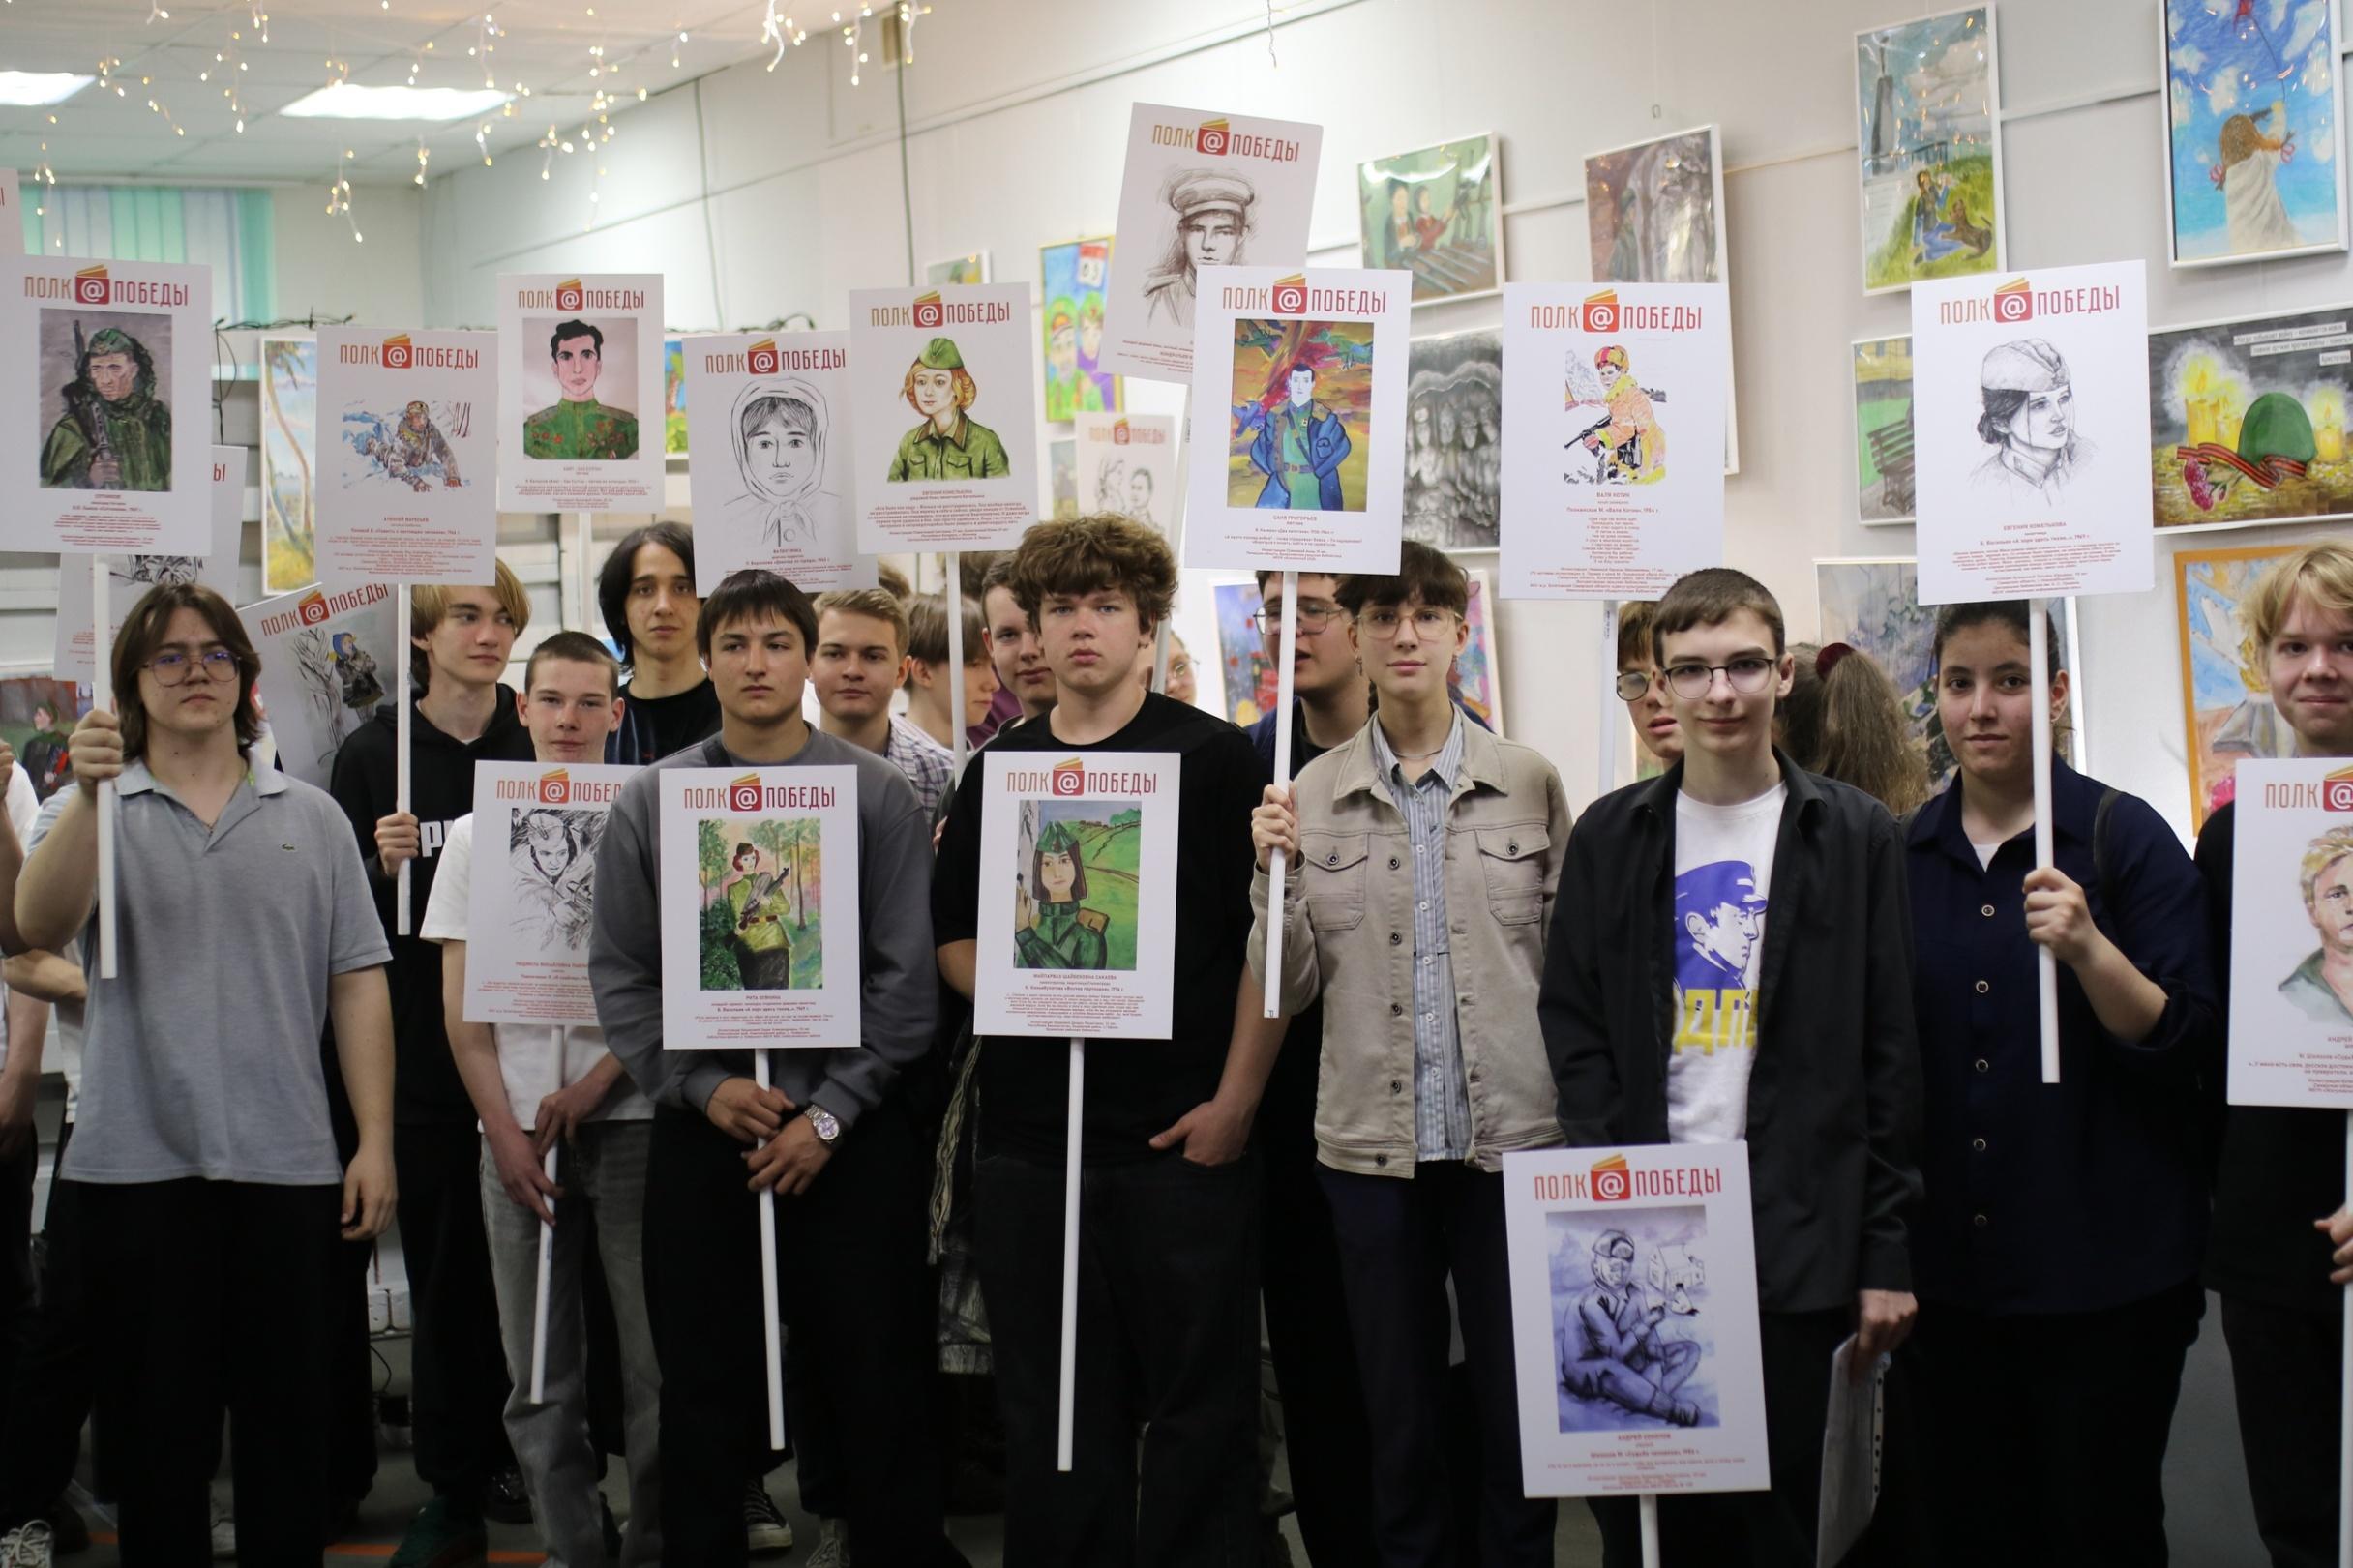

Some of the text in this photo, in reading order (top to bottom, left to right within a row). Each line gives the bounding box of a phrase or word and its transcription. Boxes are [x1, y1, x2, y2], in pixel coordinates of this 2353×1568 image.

[1152, 125, 1195, 149] ПОЛК
[1232, 134, 1299, 163] ПОБЕДЫ
[24, 276, 72, 299] ПОЛК
[115, 281, 188, 307] ПОБЕДЫ
[519, 290, 553, 309] ПОЛК
[586, 290, 644, 310] ПОБЕДЫ
[1222, 287, 1268, 310] ПОЛК
[1312, 289, 1386, 315] ПОБЕДЫ
[871, 307, 910, 327] ПОЛК
[947, 302, 1010, 324] ПОБЕДЫ
[1941, 298, 1991, 325] ПОЛК
[2038, 285, 2120, 316] ПОБЕДЫ
[1531, 306, 1578, 328] ПОЛК
[1624, 306, 1702, 332] ПОБЕДЫ
[340, 344, 379, 365] ПОЛК
[416, 347, 478, 370] ПОБЕДЫ
[705, 353, 745, 373] ПОЛК
[782, 349, 846, 370] ПОБЕДЫ
[261, 610, 300, 636] ПОЛК
[330, 584, 388, 614] ПОБЕДЫ
[496, 780, 536, 800] ПОЛК
[573, 783, 622, 803] ПОБЕД
[1007, 772, 1049, 792] ПОЛК
[1088, 773, 1156, 795] ПОБЕДЫ
[2266, 784, 2318, 808] ПОЛК
[684, 788, 727, 809] ПОЛК
[766, 786, 835, 810] ПОБЕДЫ
[1534, 1174, 1588, 1201] ПОЛК
[1635, 1168, 1722, 1197] ПОБЕДЫ
